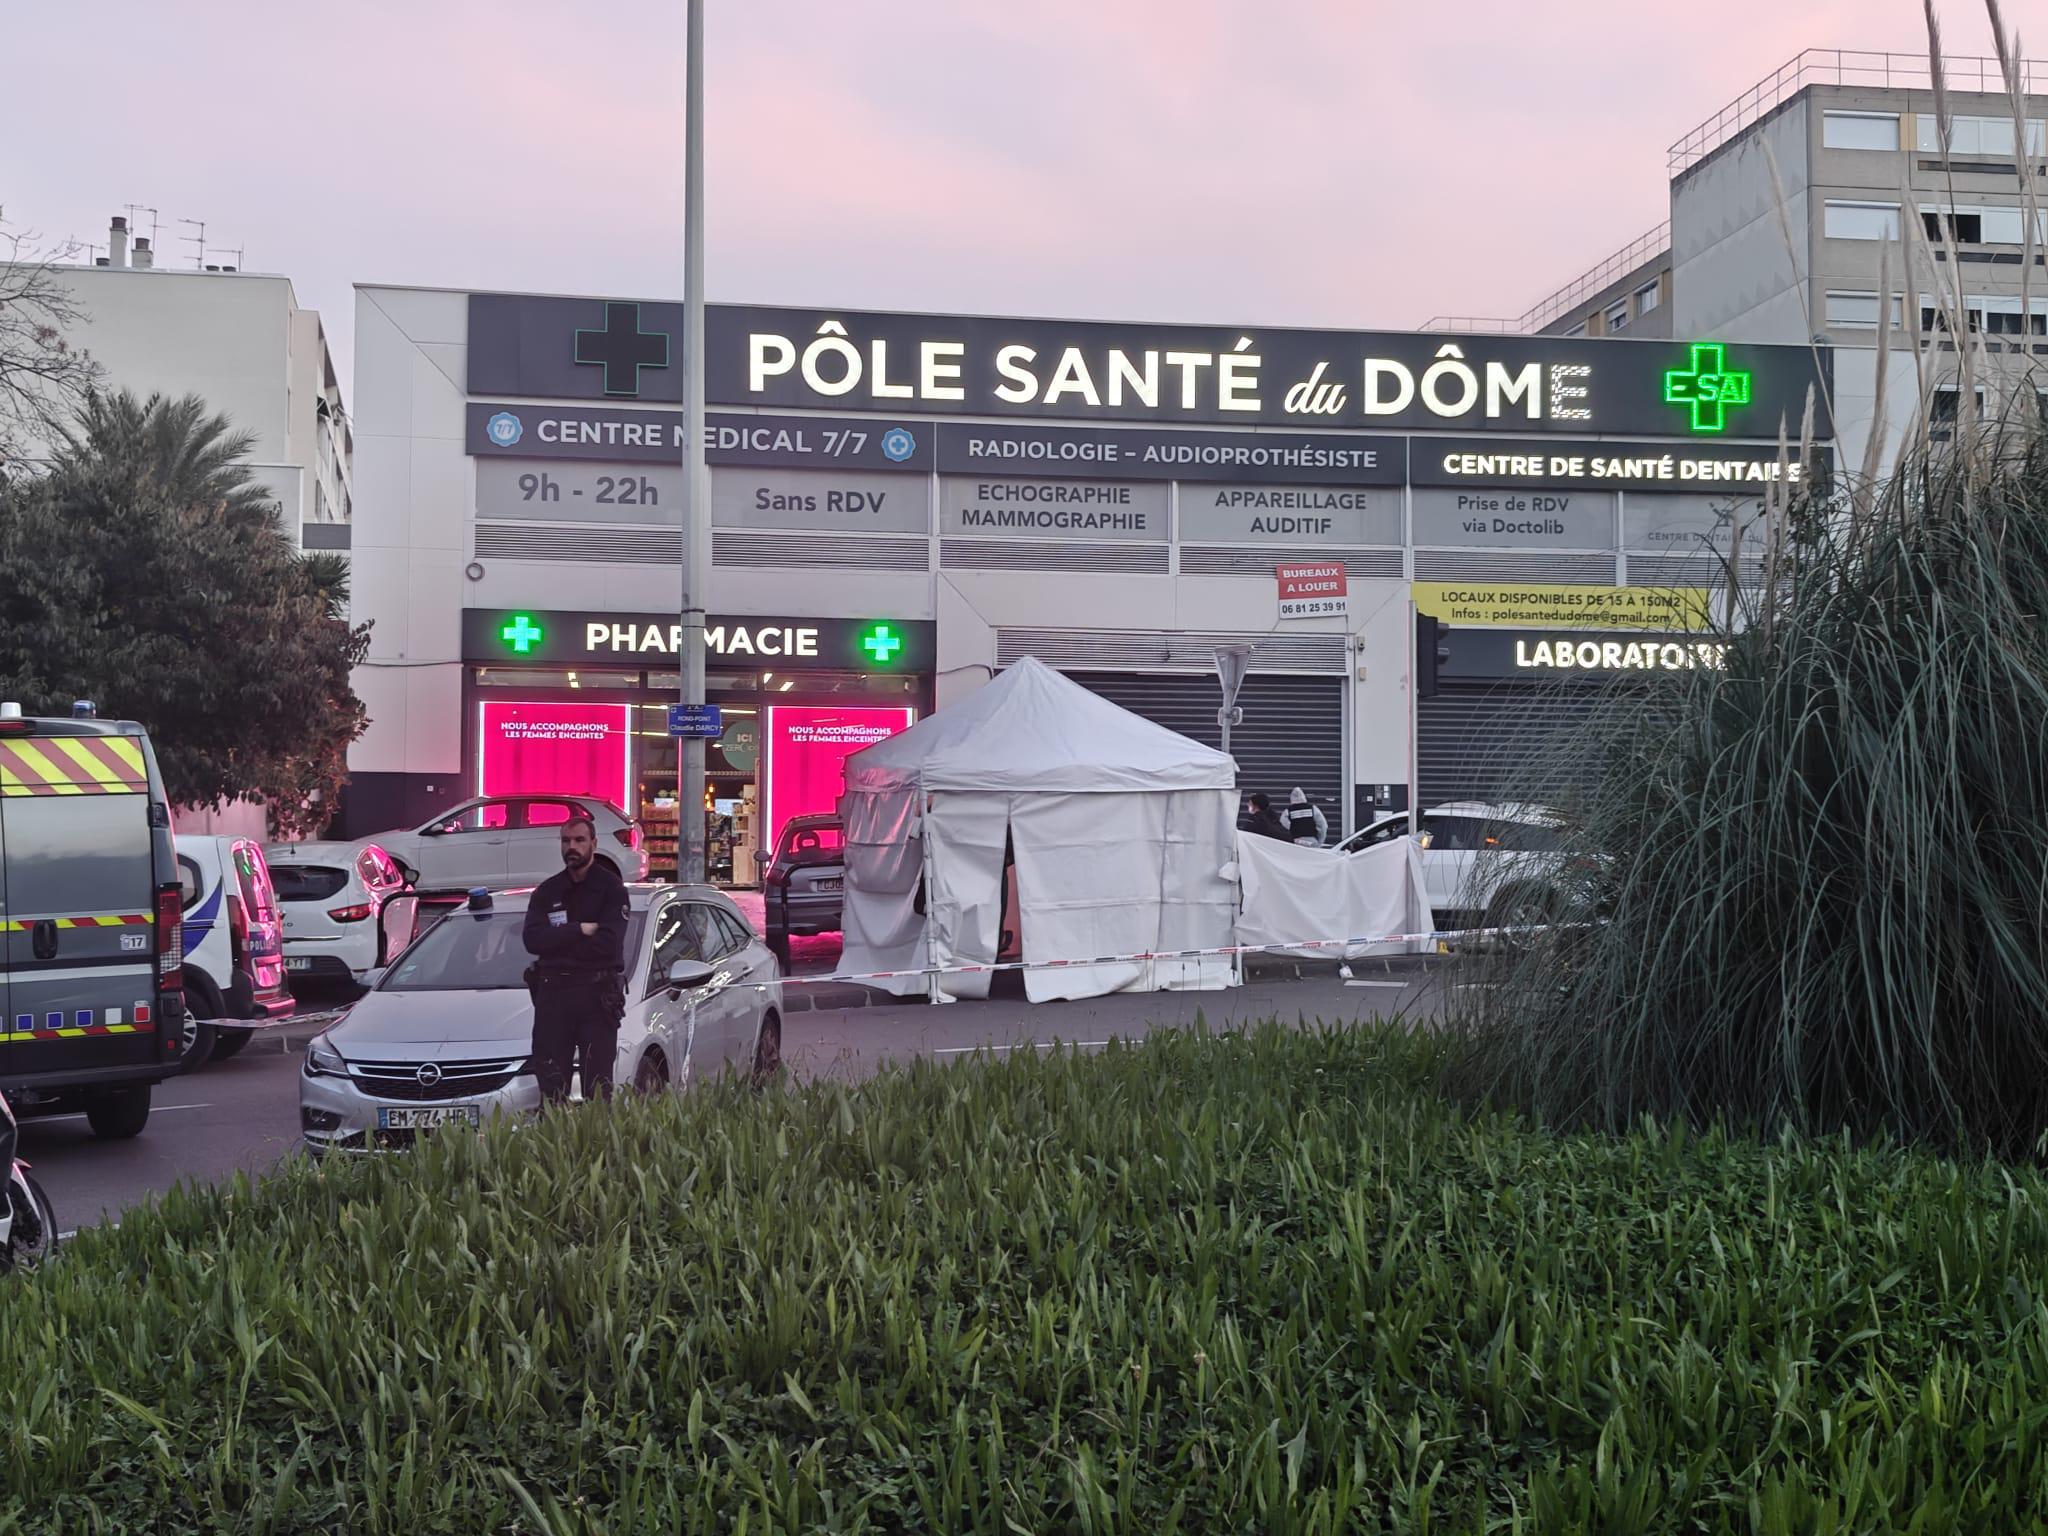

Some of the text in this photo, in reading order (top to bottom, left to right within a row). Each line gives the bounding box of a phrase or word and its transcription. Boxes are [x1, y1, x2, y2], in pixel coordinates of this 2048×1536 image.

[748, 319, 1592, 421] PÔLE SANTÉ du DÔME
[536, 418, 663, 447] CENTRE
[821, 431, 867, 455] 7/7
[968, 438, 1118, 462] RADIOLOGIE
[1143, 443, 1378, 468] AUDIOPROTHÉSISTE
[1443, 454, 1544, 477] CENTRE
[1550, 457, 1584, 478] DE
[1590, 454, 1674, 480] SANTÉ
[518, 473, 560, 502] 9h
[596, 476, 658, 505] 22h
[977, 483, 1131, 505] ECHOGRAPHIE
[755, 487, 886, 513] Sans RDV
[1215, 489, 1367, 510] APPAREILLAGE
[1457, 495, 1569, 512] Prise de RDV
[961, 509, 1147, 531] MAMMOGRAPHIE
[1250, 516, 1332, 535] AUDITIF
[1462, 518, 1565, 535] via Doctolib
[1282, 567, 1339, 579] BUREAUX
[1287, 581, 1338, 593] A LOUER
[1282, 601, 1346, 614] 06 81 25 39 91
[1441, 591, 1495, 604] LOCAUX
[1499, 592, 1583, 605] DISPONIBLES
[1586, 594, 1604, 606] DE
[1608, 595, 1622, 606] 15
[1640, 595, 1681, 607] 150M2
[1451, 608, 1481, 619] Infos
[1492, 609, 1670, 624] polesantedudome@gmail.com
[501, 722, 609, 732] NOUS ACCOMPAGNONS
[505, 731, 604, 740] LES FEMMES ENCEINTES
[788, 726, 814, 735] NOUS
[737, 734, 752, 743] ICI
[792, 734, 807, 742] LES
